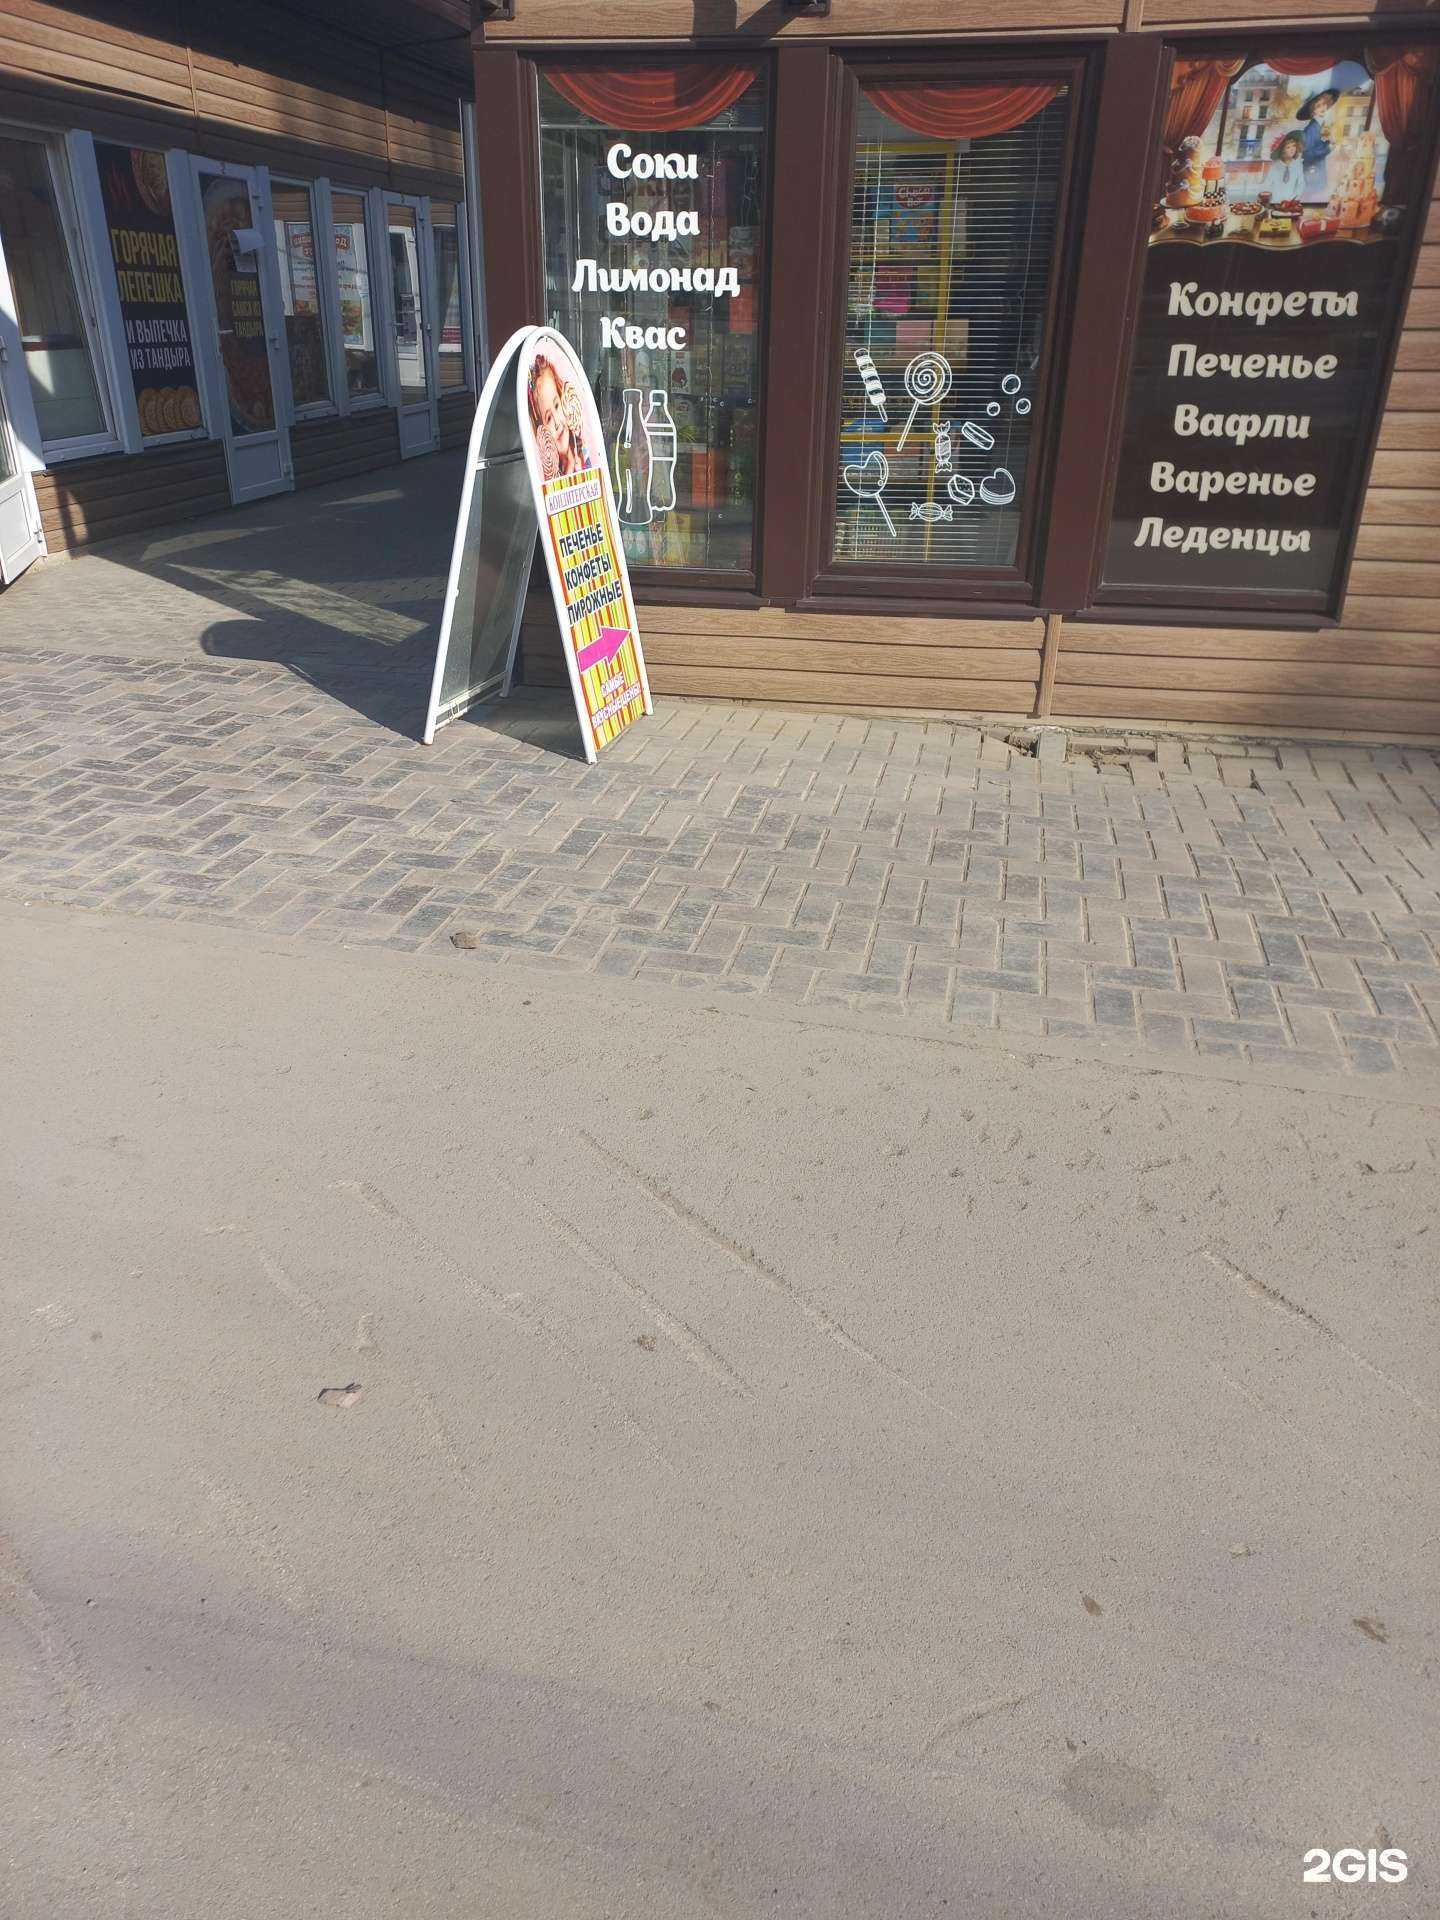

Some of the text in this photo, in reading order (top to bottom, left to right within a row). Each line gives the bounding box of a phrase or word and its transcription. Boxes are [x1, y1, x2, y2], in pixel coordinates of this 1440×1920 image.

[608, 143, 699, 179] Соки
[606, 202, 700, 242] Вода
[111, 228, 178, 266] ГОРЯЧАЯ
[117, 270, 184, 304] ЛЕПЕШКА
[571, 259, 741, 298] Лимонад
[1168, 282, 1359, 325] Конфеты
[126, 319, 188, 344] И ВЫПЕЧКА
[600, 316, 687, 351] Квас
[129, 347, 191, 371] ИЗ ТАНДЫРА
[1168, 344, 1338, 379] Печенье
[1174, 404, 1311, 445] Вафли
[548, 482, 600, 512] КОНДИТЕРСКАЯ
[1151, 461, 1317, 501] Варенье
[559, 522, 604, 558] ПЕЧЕНЬЕ
[1134, 517, 1311, 556] Леденцы
[564, 552, 612, 590] КОНФЕТЫ
[567, 580, 623, 625] ПИРОЖНЫЕ
